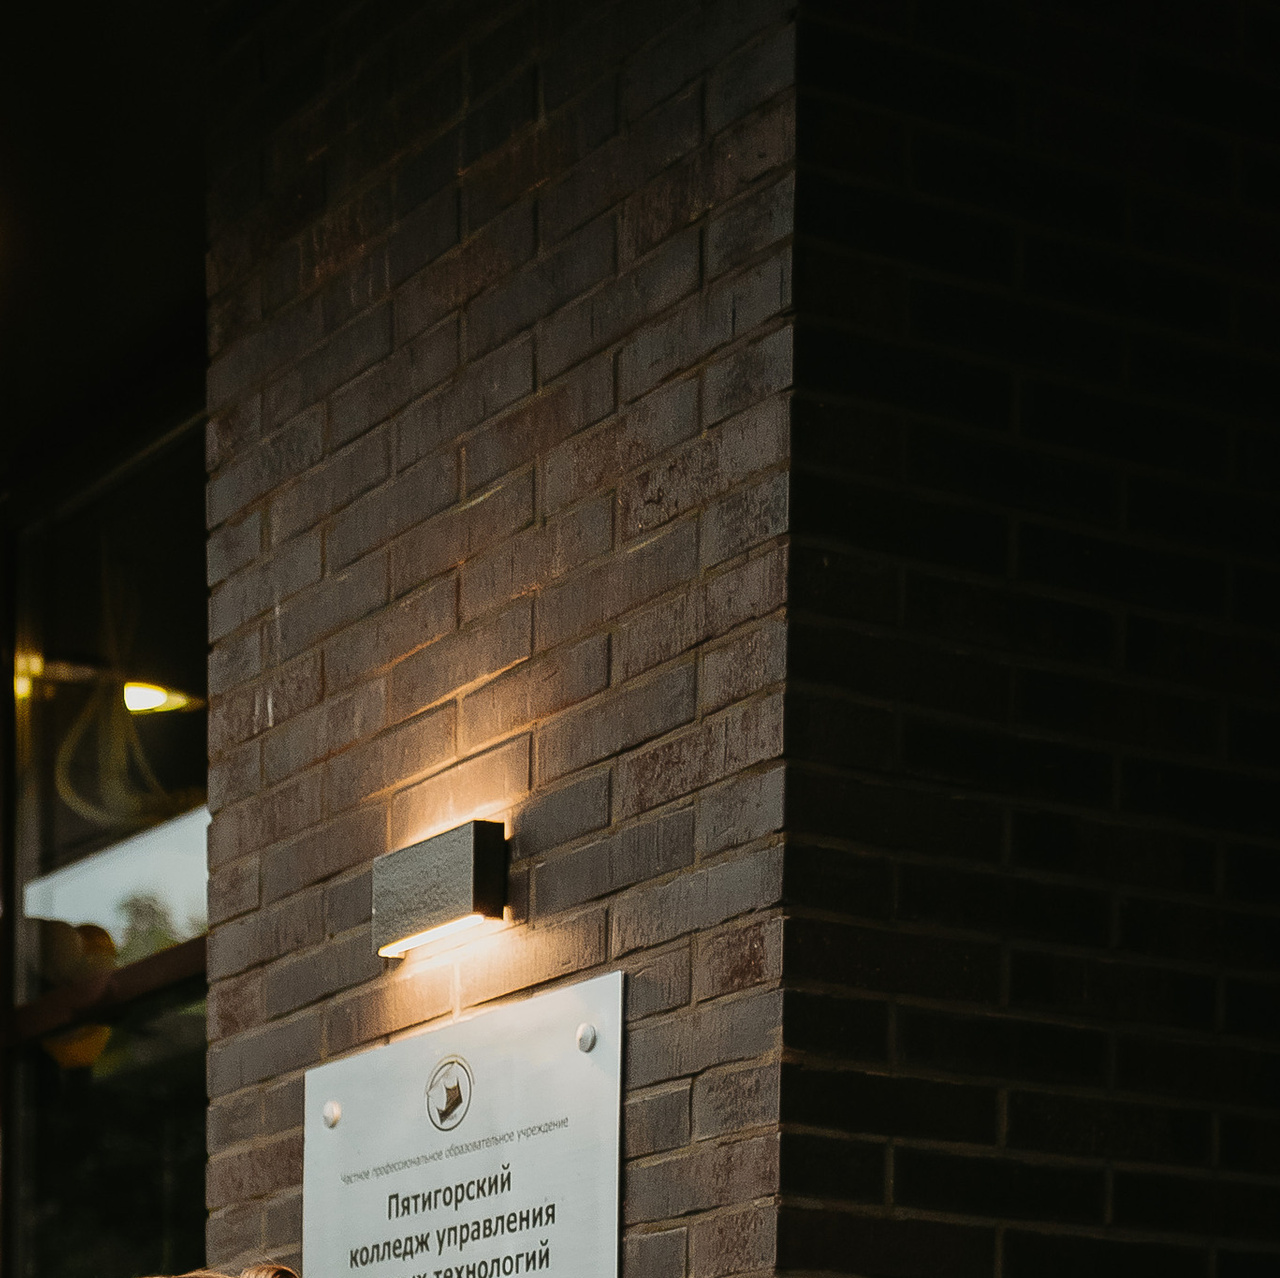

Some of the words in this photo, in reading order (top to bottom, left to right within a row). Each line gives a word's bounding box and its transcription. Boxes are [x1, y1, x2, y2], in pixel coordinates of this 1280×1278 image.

[387, 1163, 512, 1220] Пятигорский
[349, 1231, 430, 1269] колледж
[435, 1203, 556, 1256] управления
